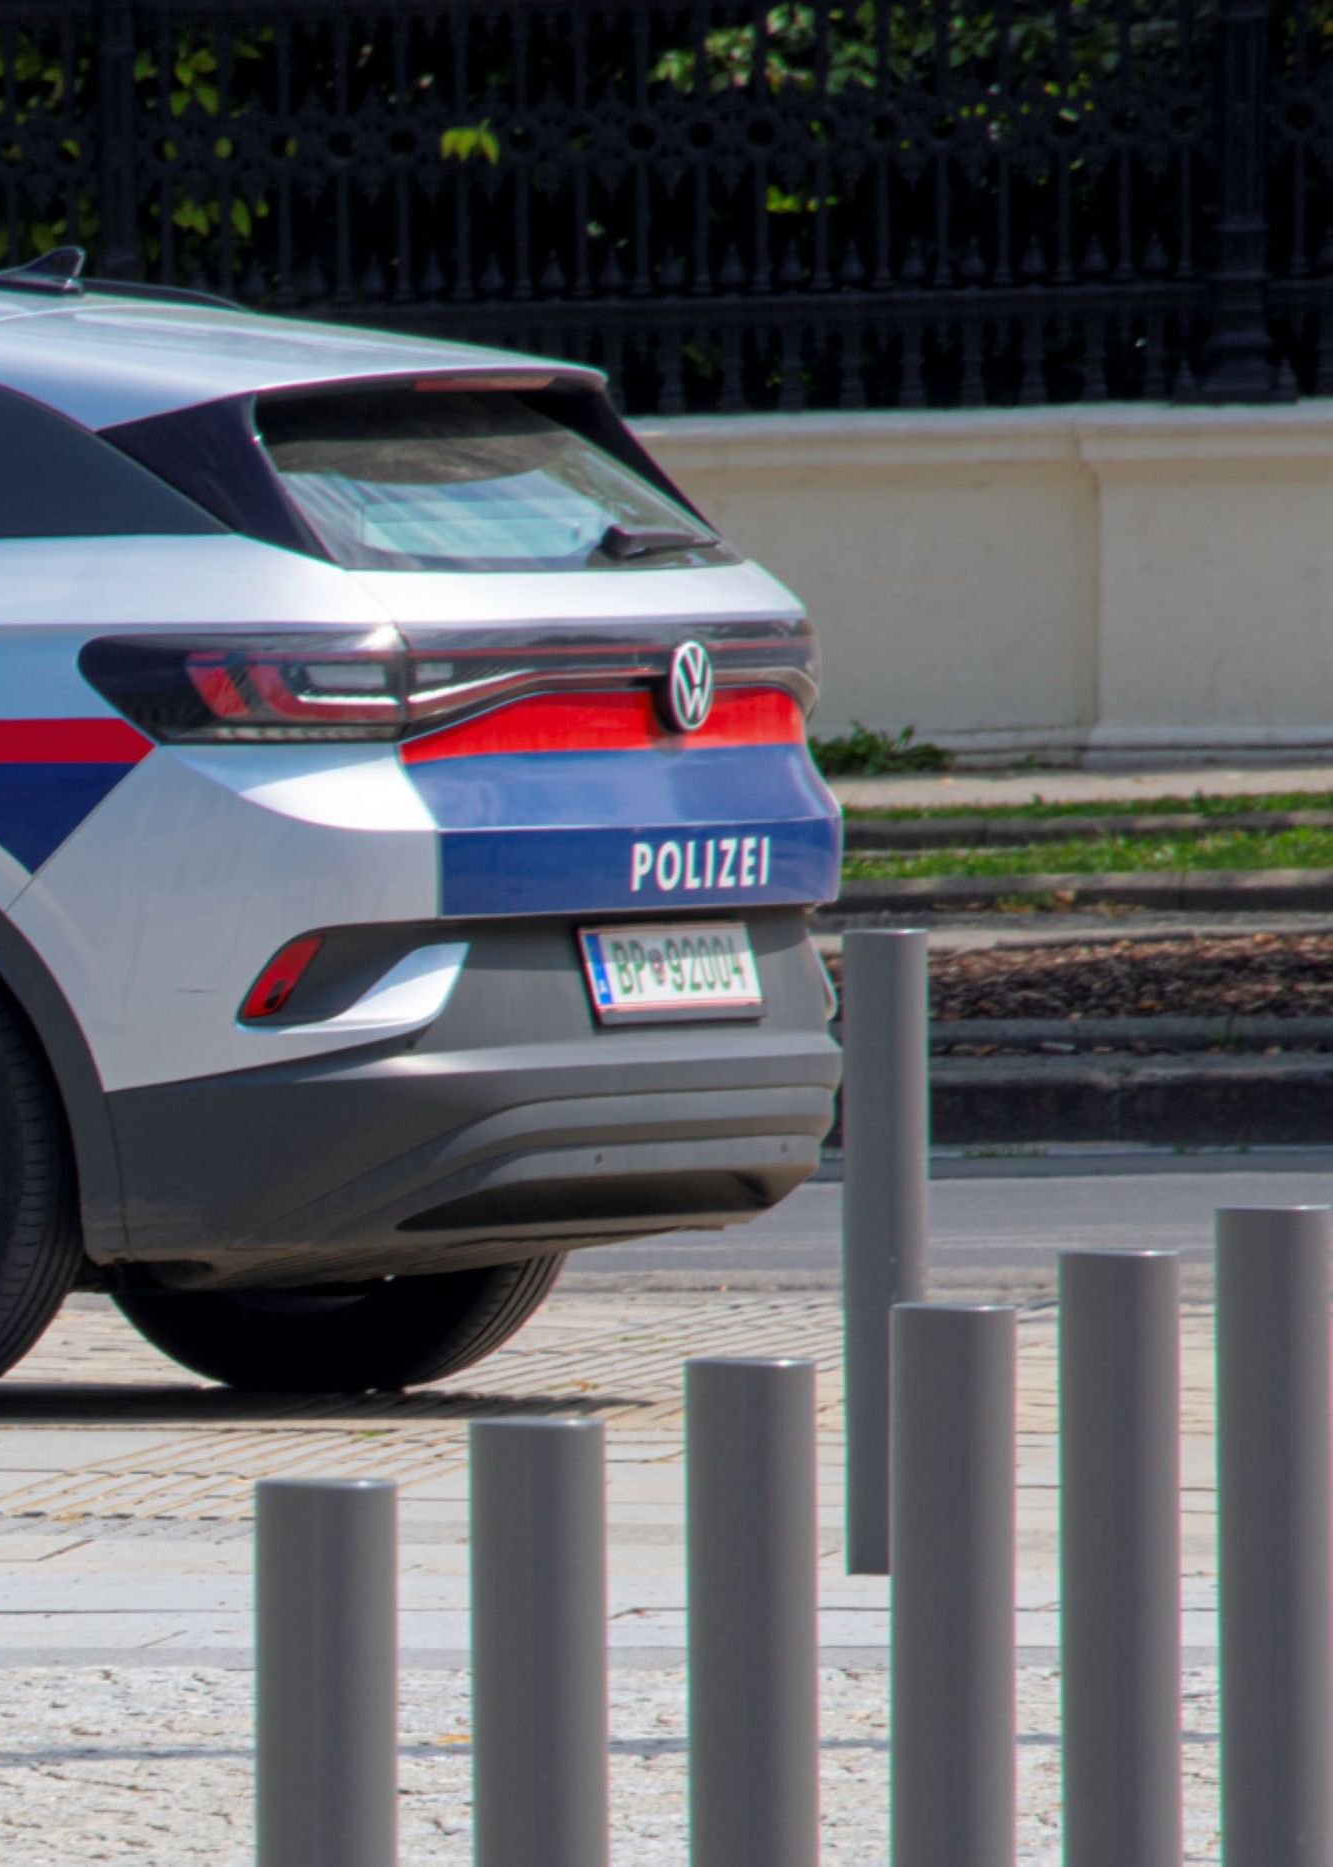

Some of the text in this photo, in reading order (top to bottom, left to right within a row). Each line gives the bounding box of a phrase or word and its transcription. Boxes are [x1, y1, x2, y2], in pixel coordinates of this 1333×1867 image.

[671, 641, 712, 730] VW
[630, 836, 770, 891] POLIZEI
[611, 936, 747, 995] BP 92004
